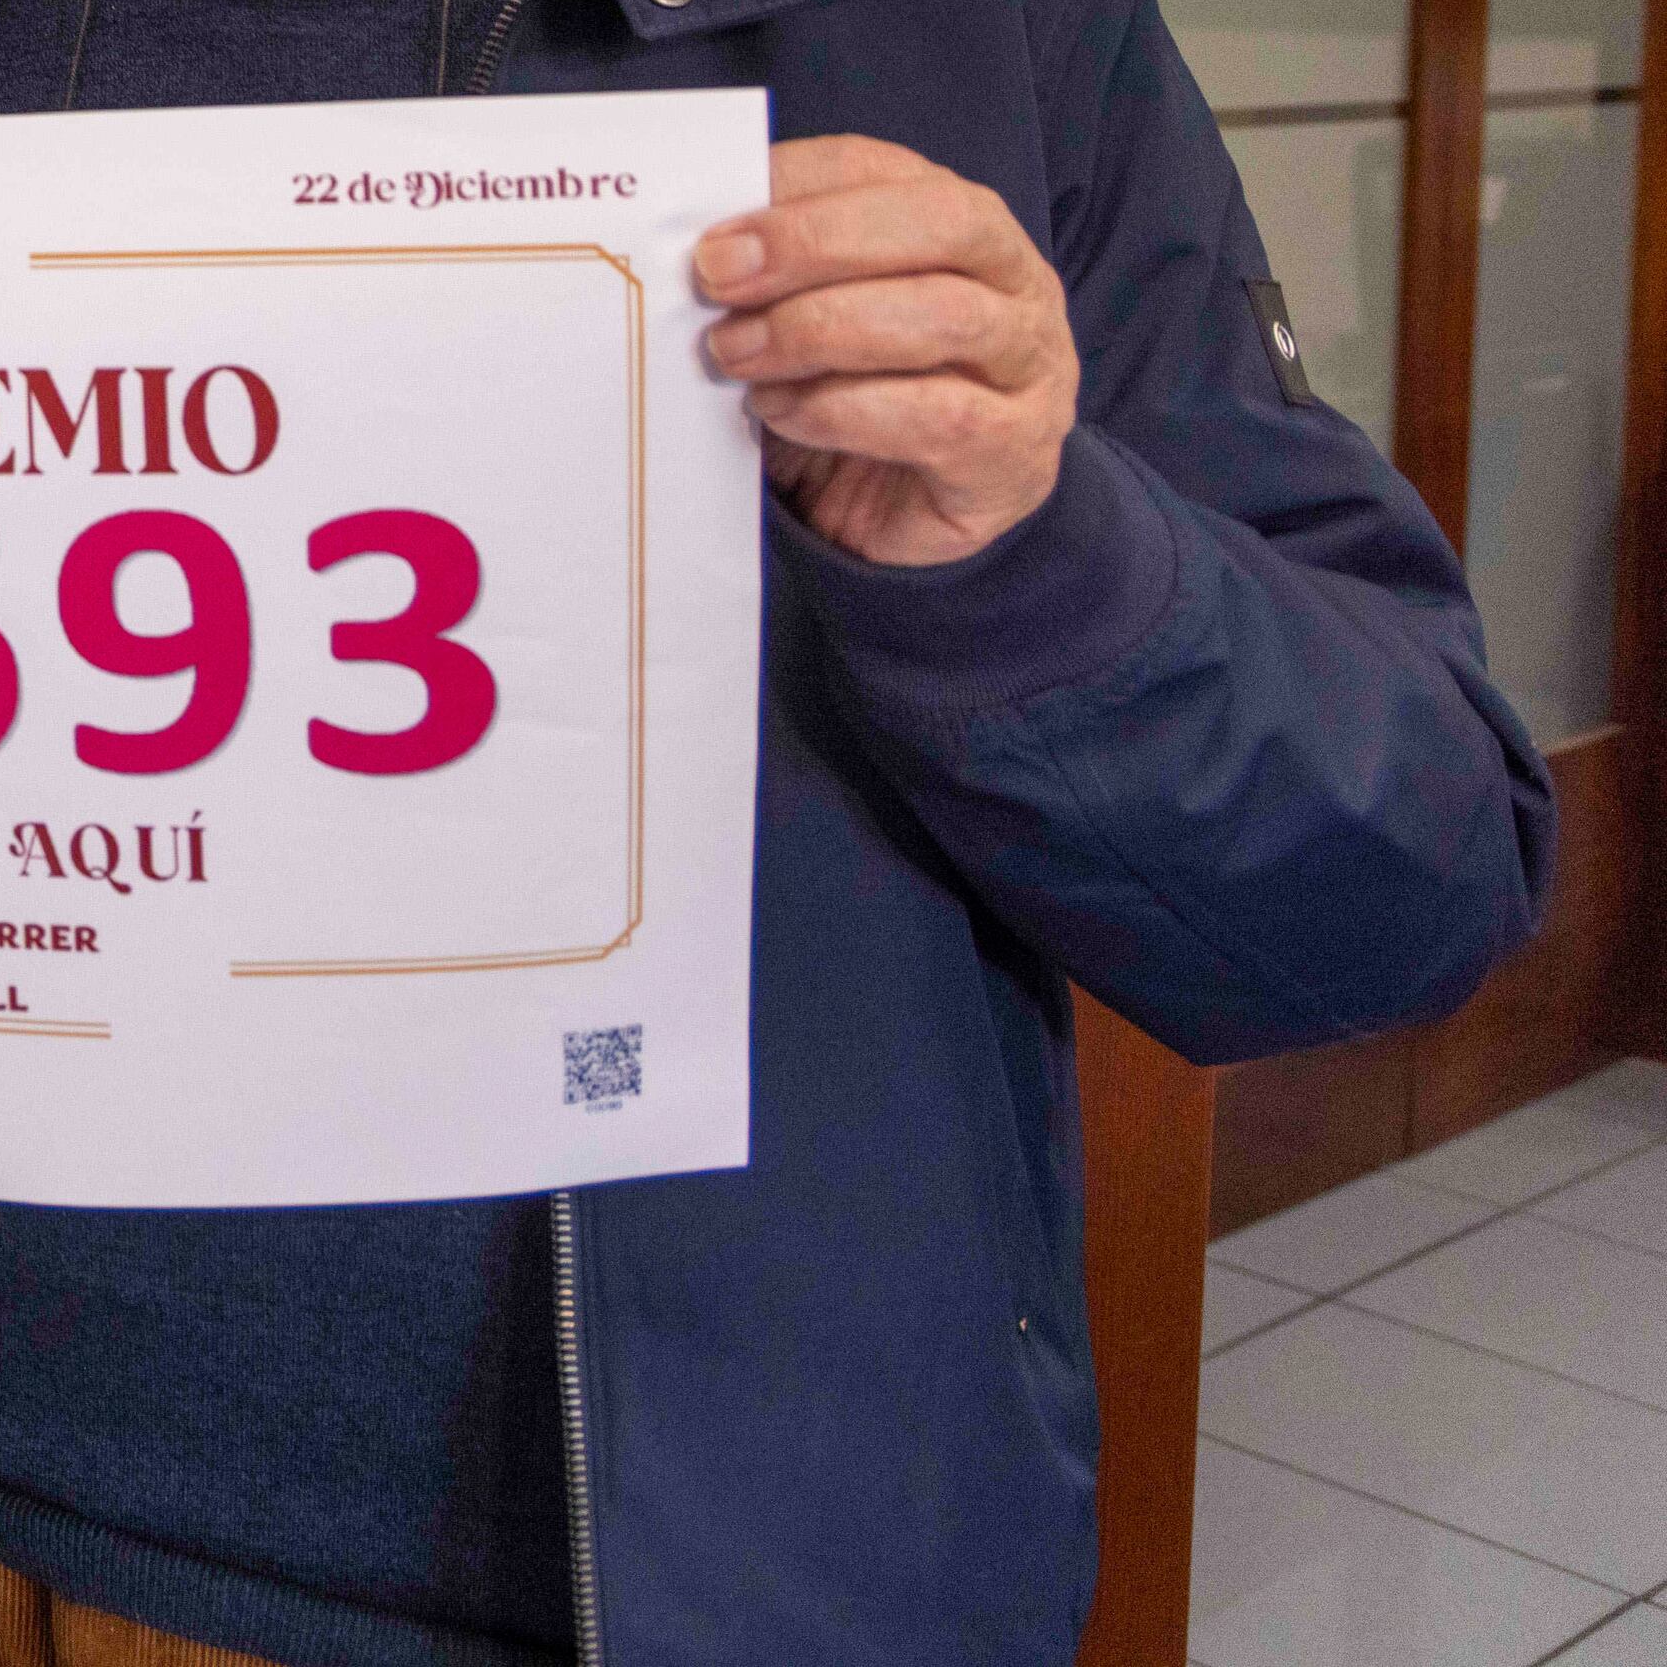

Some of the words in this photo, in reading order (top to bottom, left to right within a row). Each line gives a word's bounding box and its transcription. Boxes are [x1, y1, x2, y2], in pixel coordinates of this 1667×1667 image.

[291, 171, 340, 205] 22
[347, 170, 397, 204] de
[404, 166, 639, 210] Diciembre
[7, 810, 210, 895] AQUÍ
